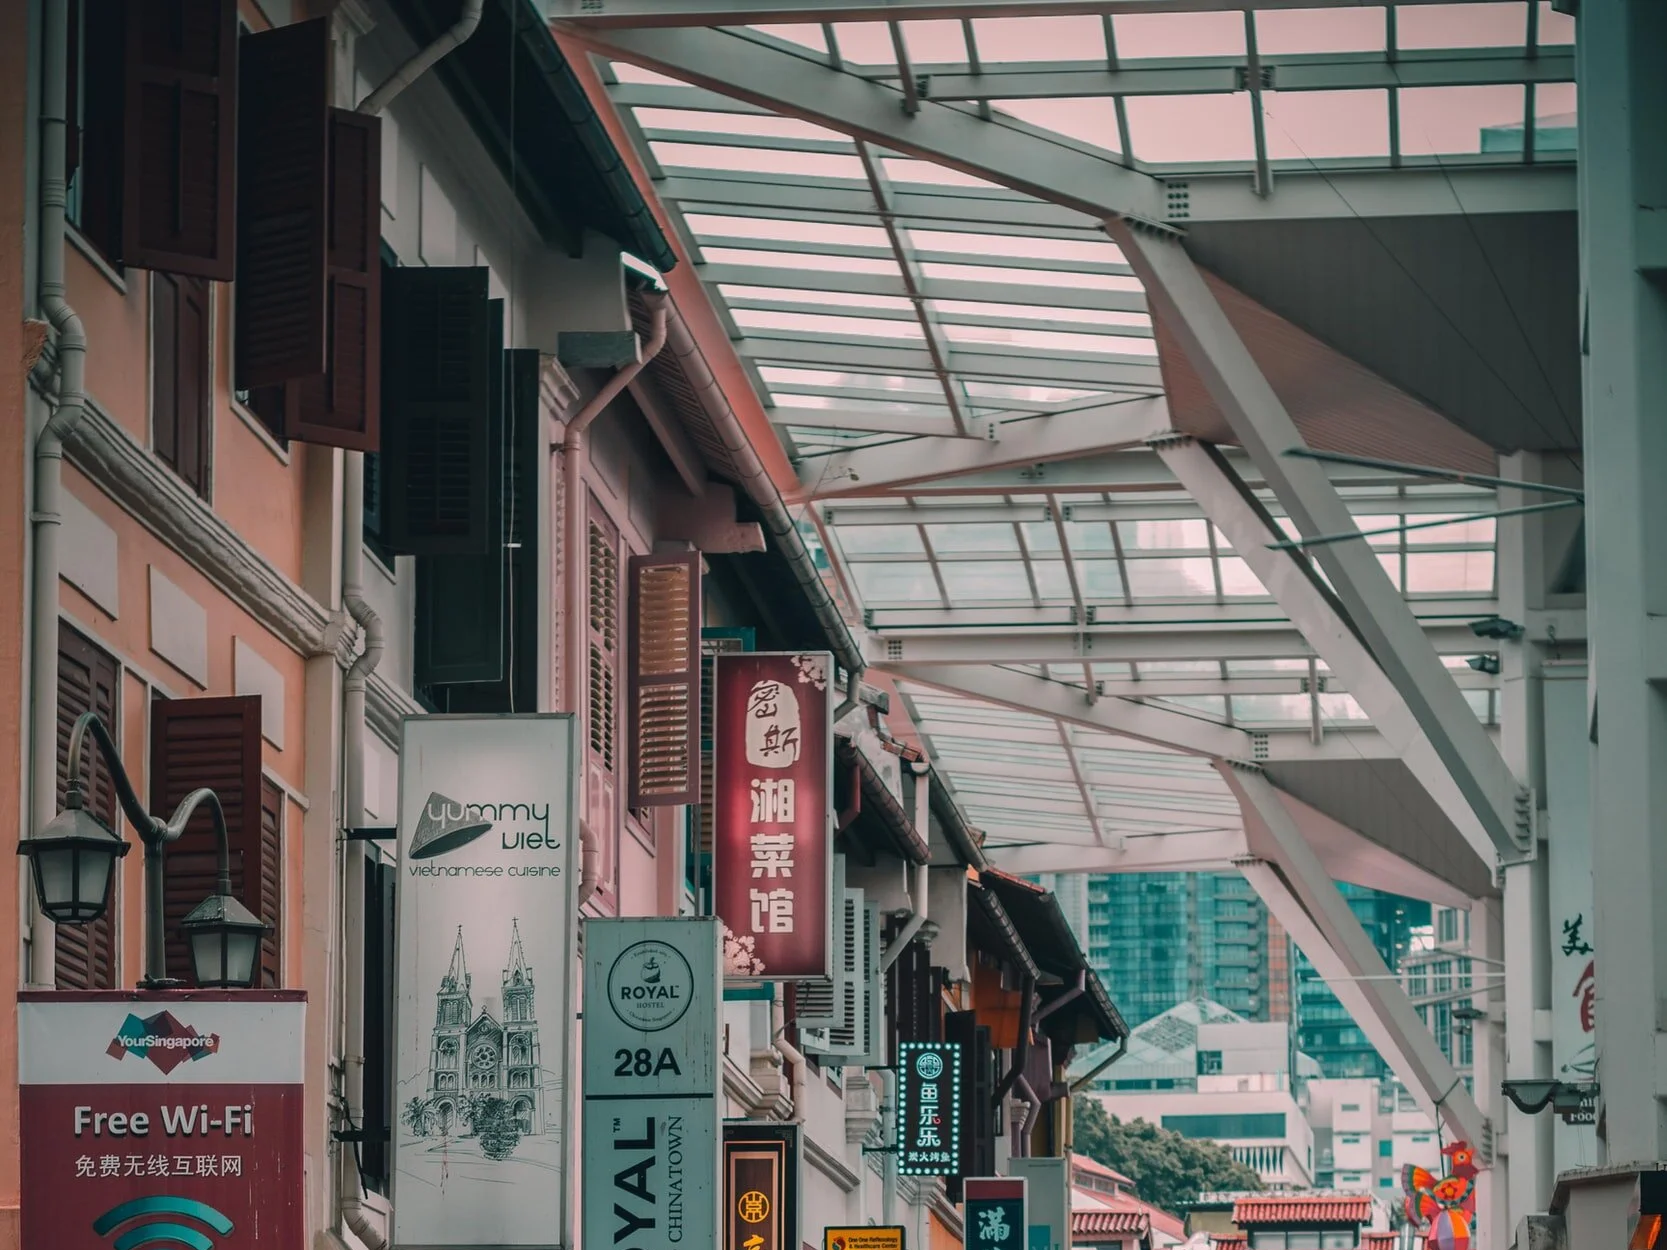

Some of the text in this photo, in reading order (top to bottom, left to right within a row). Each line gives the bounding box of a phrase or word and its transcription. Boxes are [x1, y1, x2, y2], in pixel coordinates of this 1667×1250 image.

[409, 860, 561, 877] vietnamese cuisine
[750, 779, 795, 933] 湘菜馆
[621, 986, 679, 1000] ROYAL
[118, 1035, 214, 1049] YourSingapore
[614, 1047, 682, 1077] 28A
[74, 1104, 252, 1135] Free Wi-Fi
[75, 1154, 242, 1177] 免费无线互联网
[668, 1115, 683, 1243] CHINATOWN
